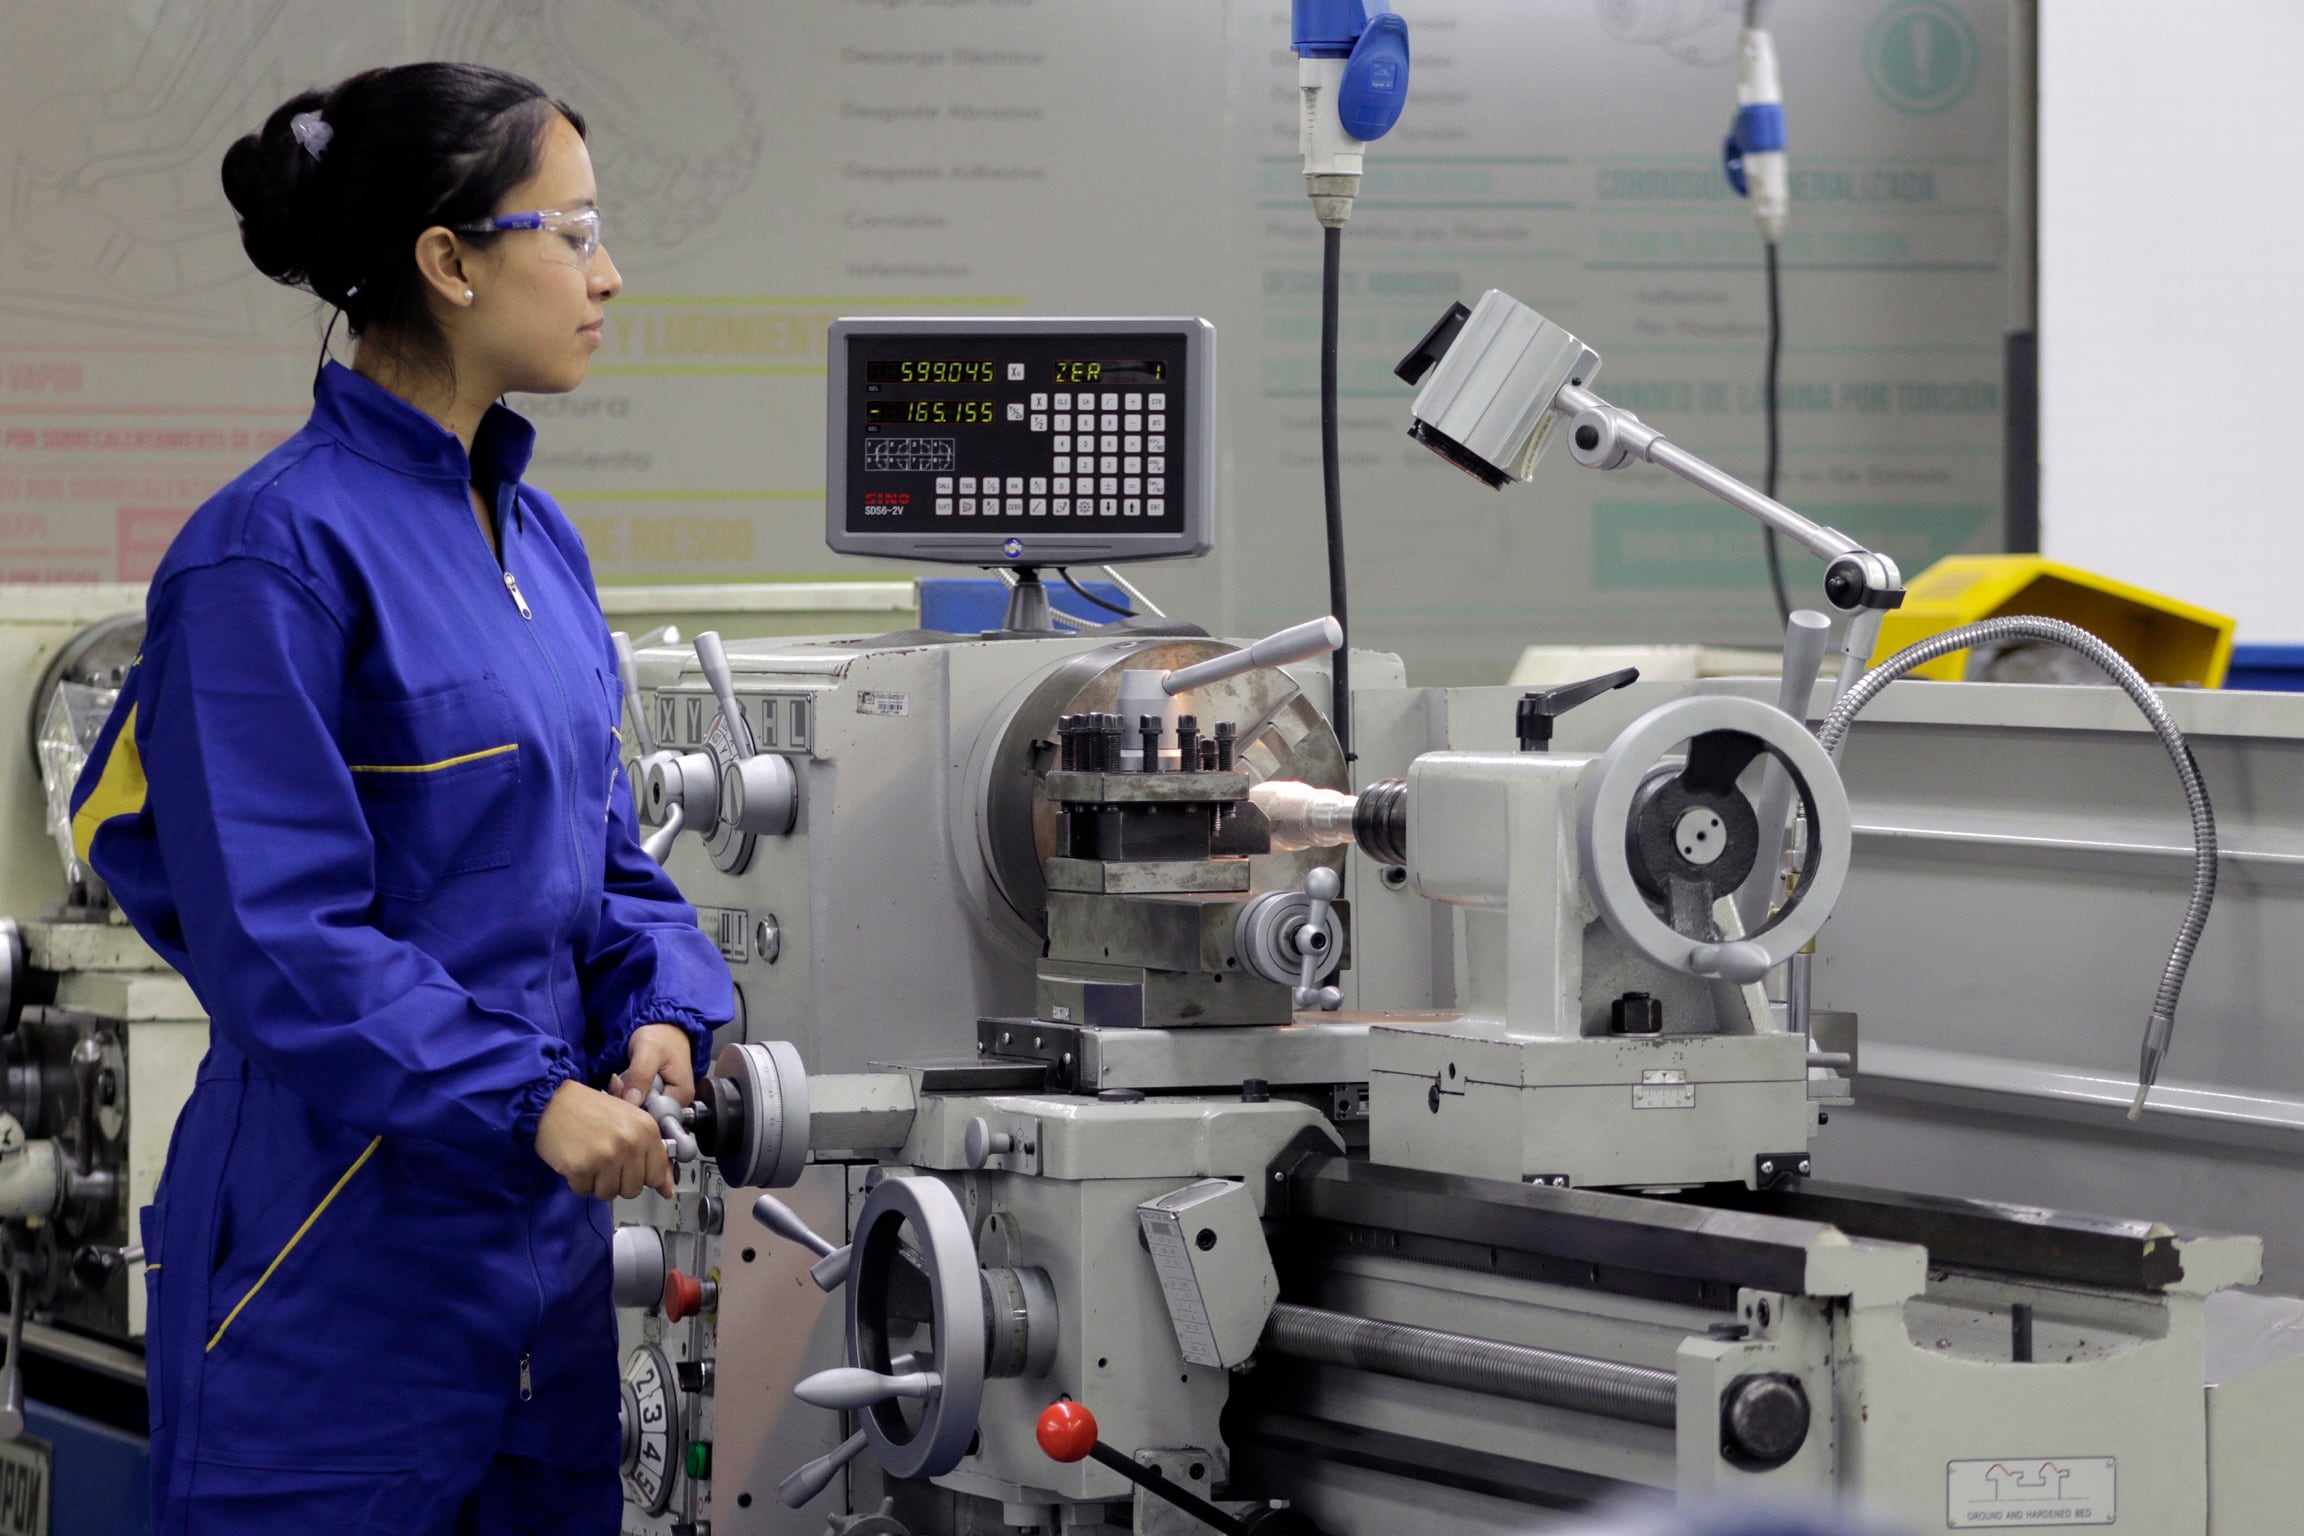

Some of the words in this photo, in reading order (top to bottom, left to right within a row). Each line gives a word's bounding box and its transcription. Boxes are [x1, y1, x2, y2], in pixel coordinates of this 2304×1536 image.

[902, 362, 993, 382] 599.045
[1056, 362, 1101, 382] ZER
[864, 493, 911, 505] SINO
[864, 506, 904, 515] SDS6-2V
[661, 699, 675, 741] X
[688, 699, 701, 743] Y
[763, 700, 777, 746] H
[791, 701, 806, 746] L
[635, 1368, 656, 1393] 2
[643, 1403, 663, 1424] 3
[643, 1441, 662, 1464] 4
[636, 1467, 656, 1497] 5
[1967, 1511, 2003, 1521] GROUND
[2006, 1510, 2023, 1520] AND
[2026, 1509, 2071, 1519] HARDENED
[2074, 1508, 2092, 1518] BED
